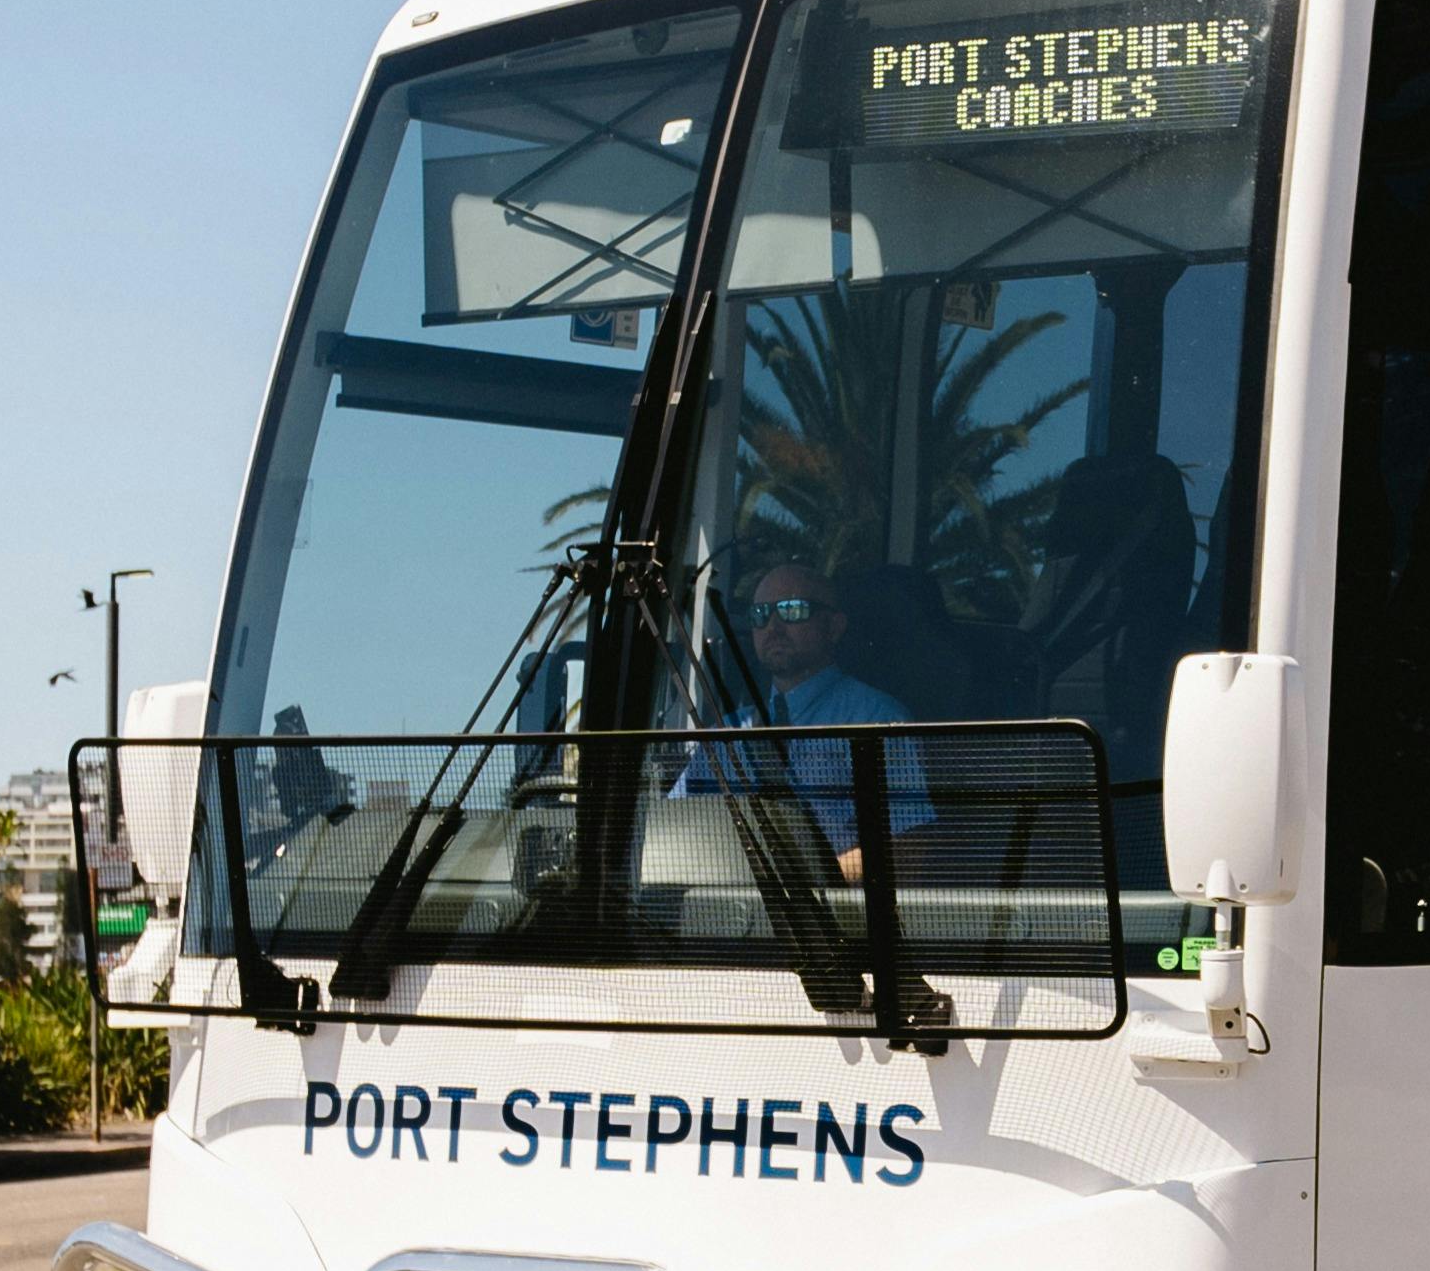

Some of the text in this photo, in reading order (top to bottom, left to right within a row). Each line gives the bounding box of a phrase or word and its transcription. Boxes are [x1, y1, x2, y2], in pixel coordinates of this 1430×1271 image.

[873, 19, 1249, 89] PORT STEPHENS
[957, 74, 1157, 130] COACHES
[304, 1081, 926, 1187] PORT STEPHENS
